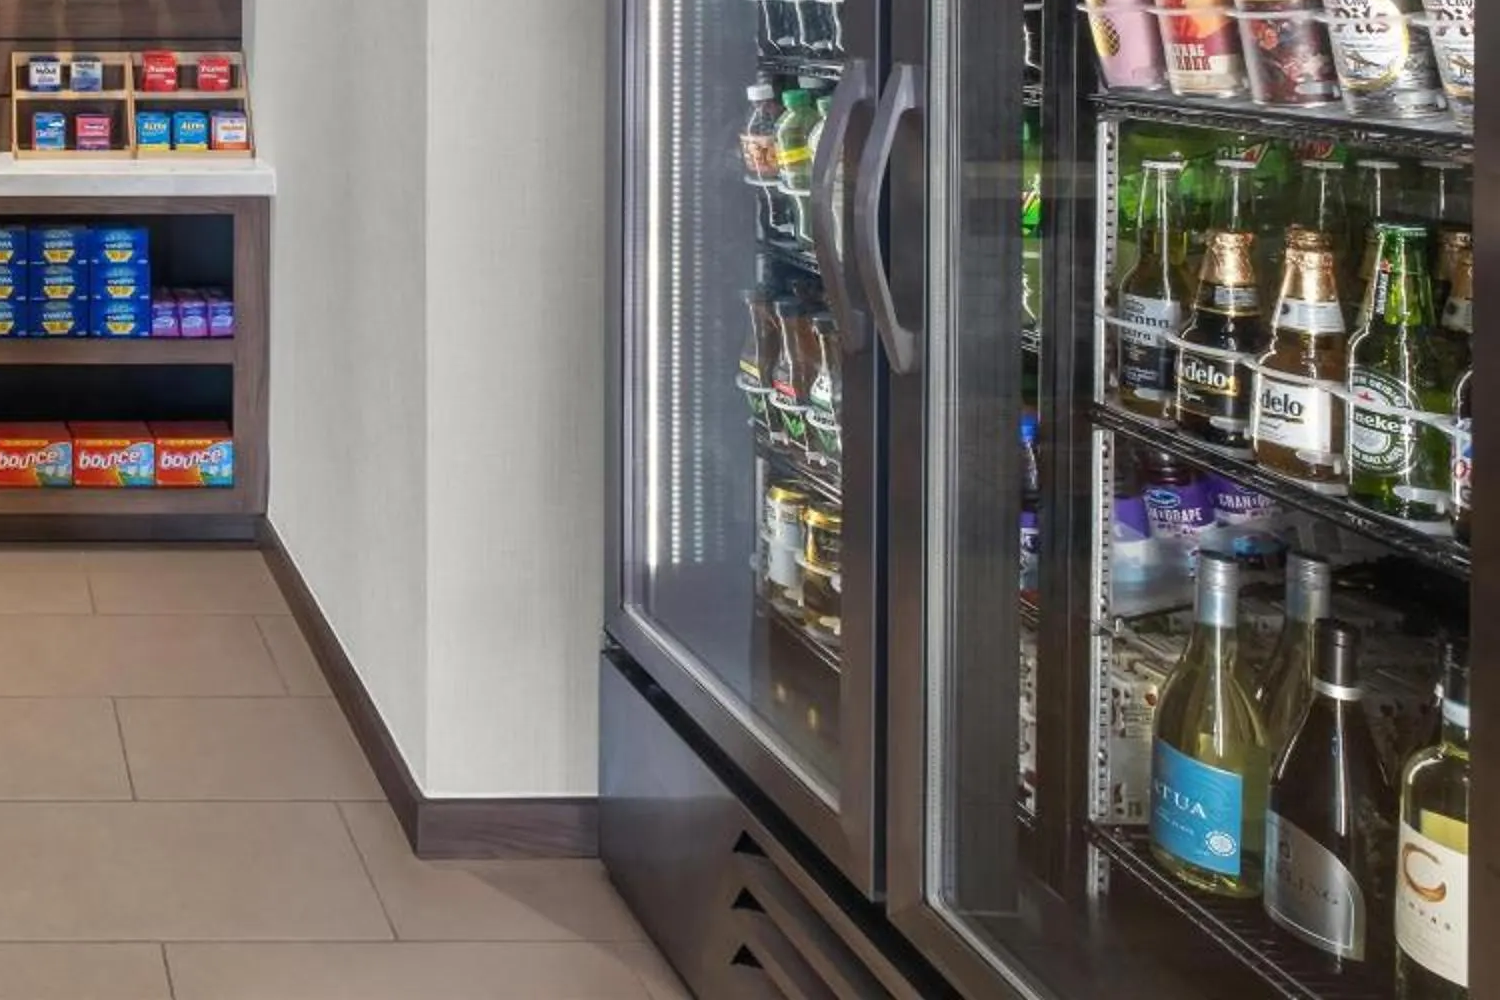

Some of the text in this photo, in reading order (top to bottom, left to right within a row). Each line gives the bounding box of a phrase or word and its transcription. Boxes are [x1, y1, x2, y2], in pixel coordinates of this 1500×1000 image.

[1261, 389, 1305, 417] delo
[79, 450, 141, 470] bounce
[161, 449, 222, 469] bounce
